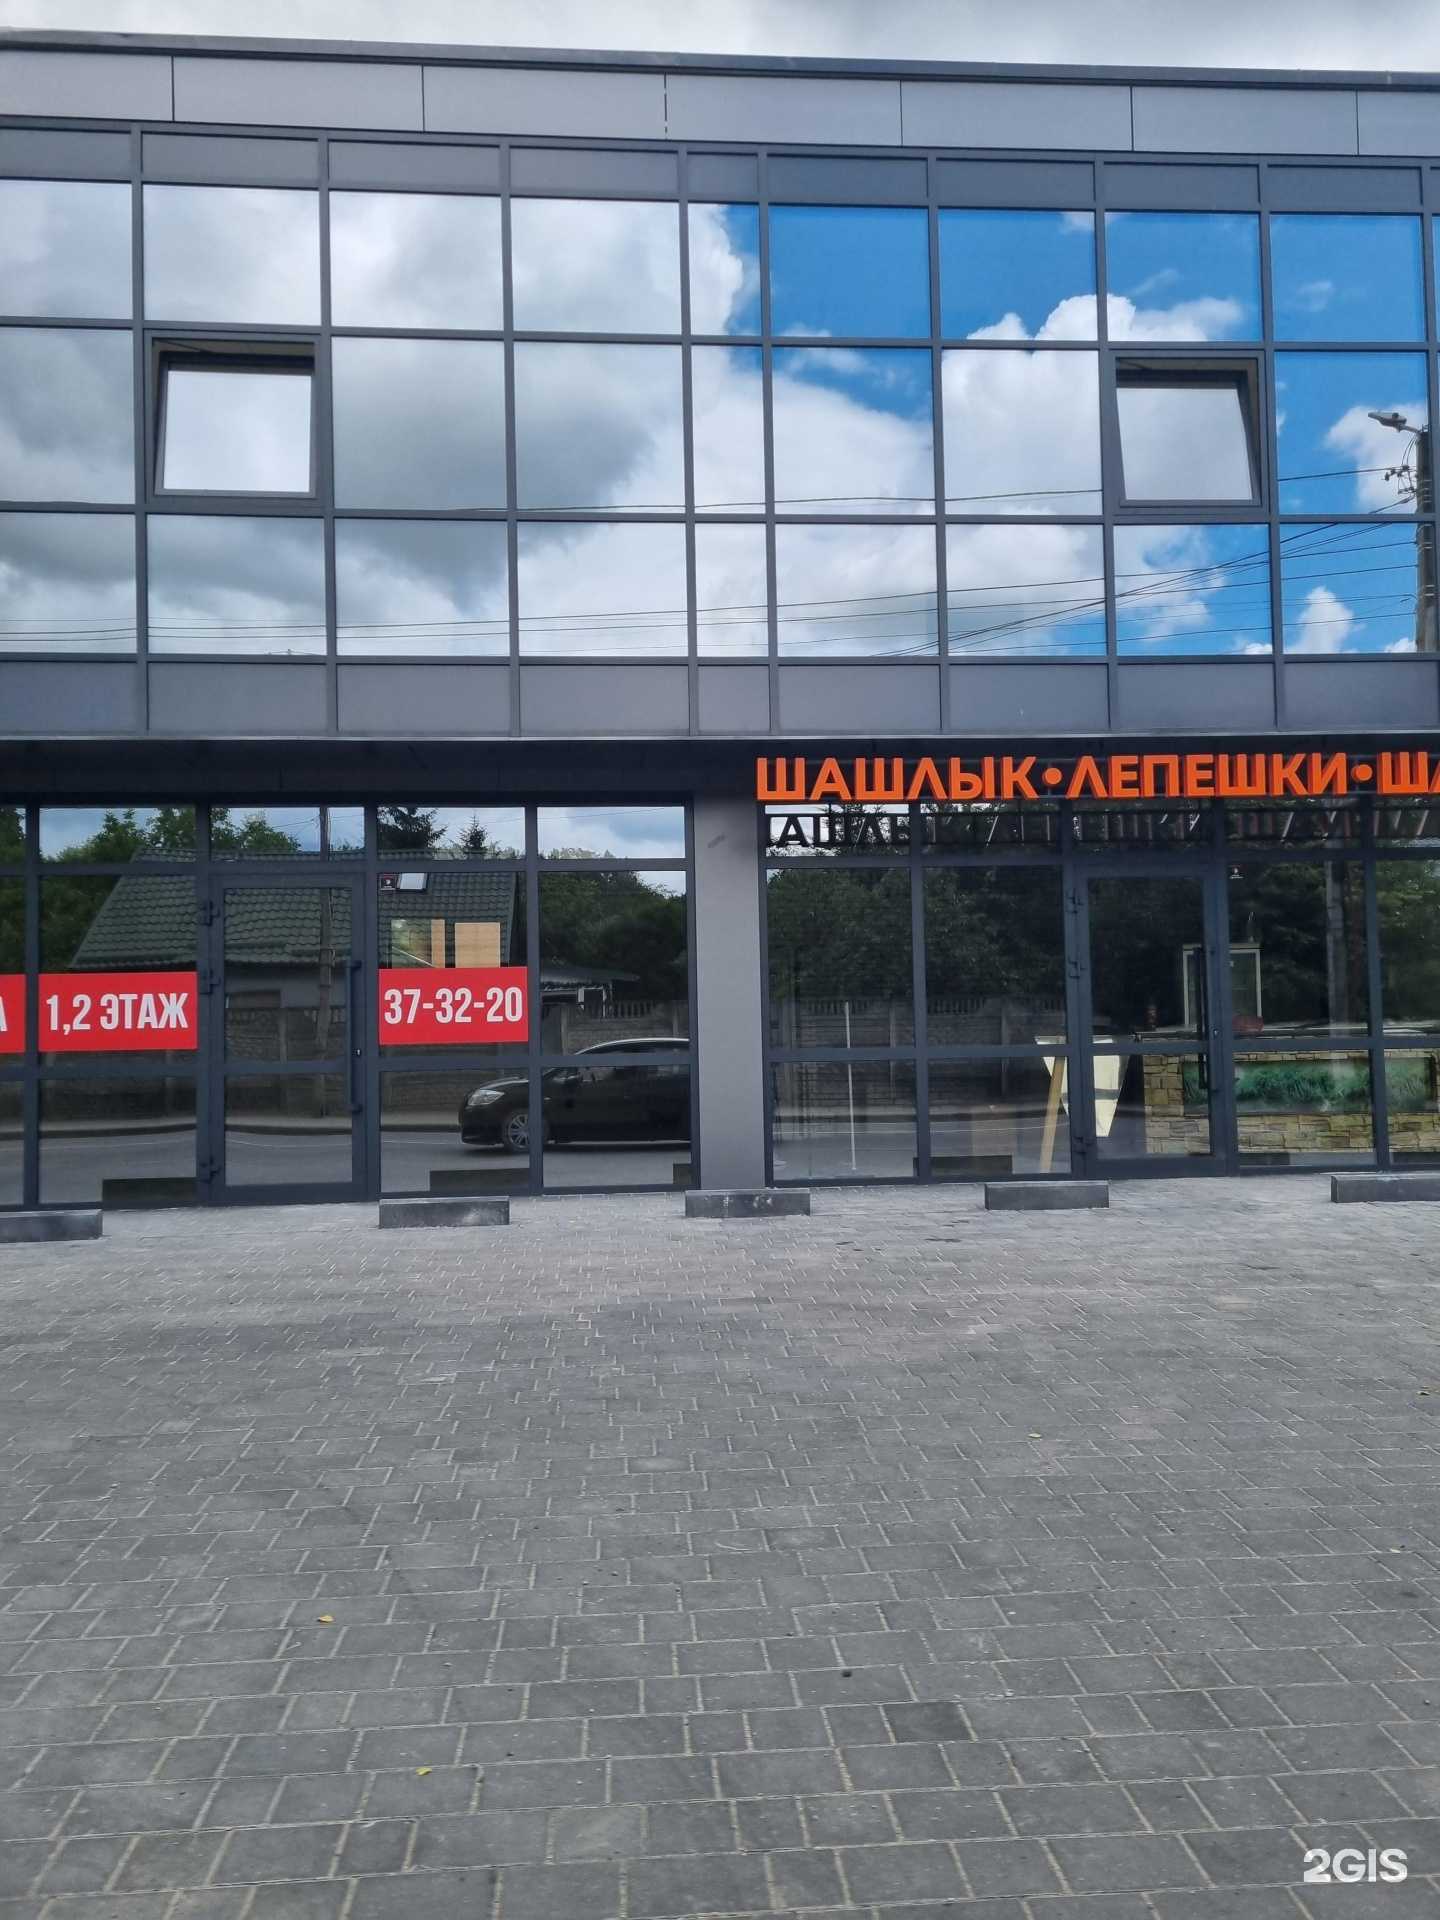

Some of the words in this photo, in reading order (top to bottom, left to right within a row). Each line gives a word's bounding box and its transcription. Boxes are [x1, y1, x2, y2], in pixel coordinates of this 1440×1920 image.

[756, 755, 1040, 800] ШАШЛЫК
[1065, 752, 1347, 799] ЛЕПЕШКИ
[1377, 751, 1440, 795] Ш
[46, 993, 91, 1036] 1,2
[100, 992, 189, 1030] ЭТАЖ
[383, 986, 523, 1025] 37-32-20
